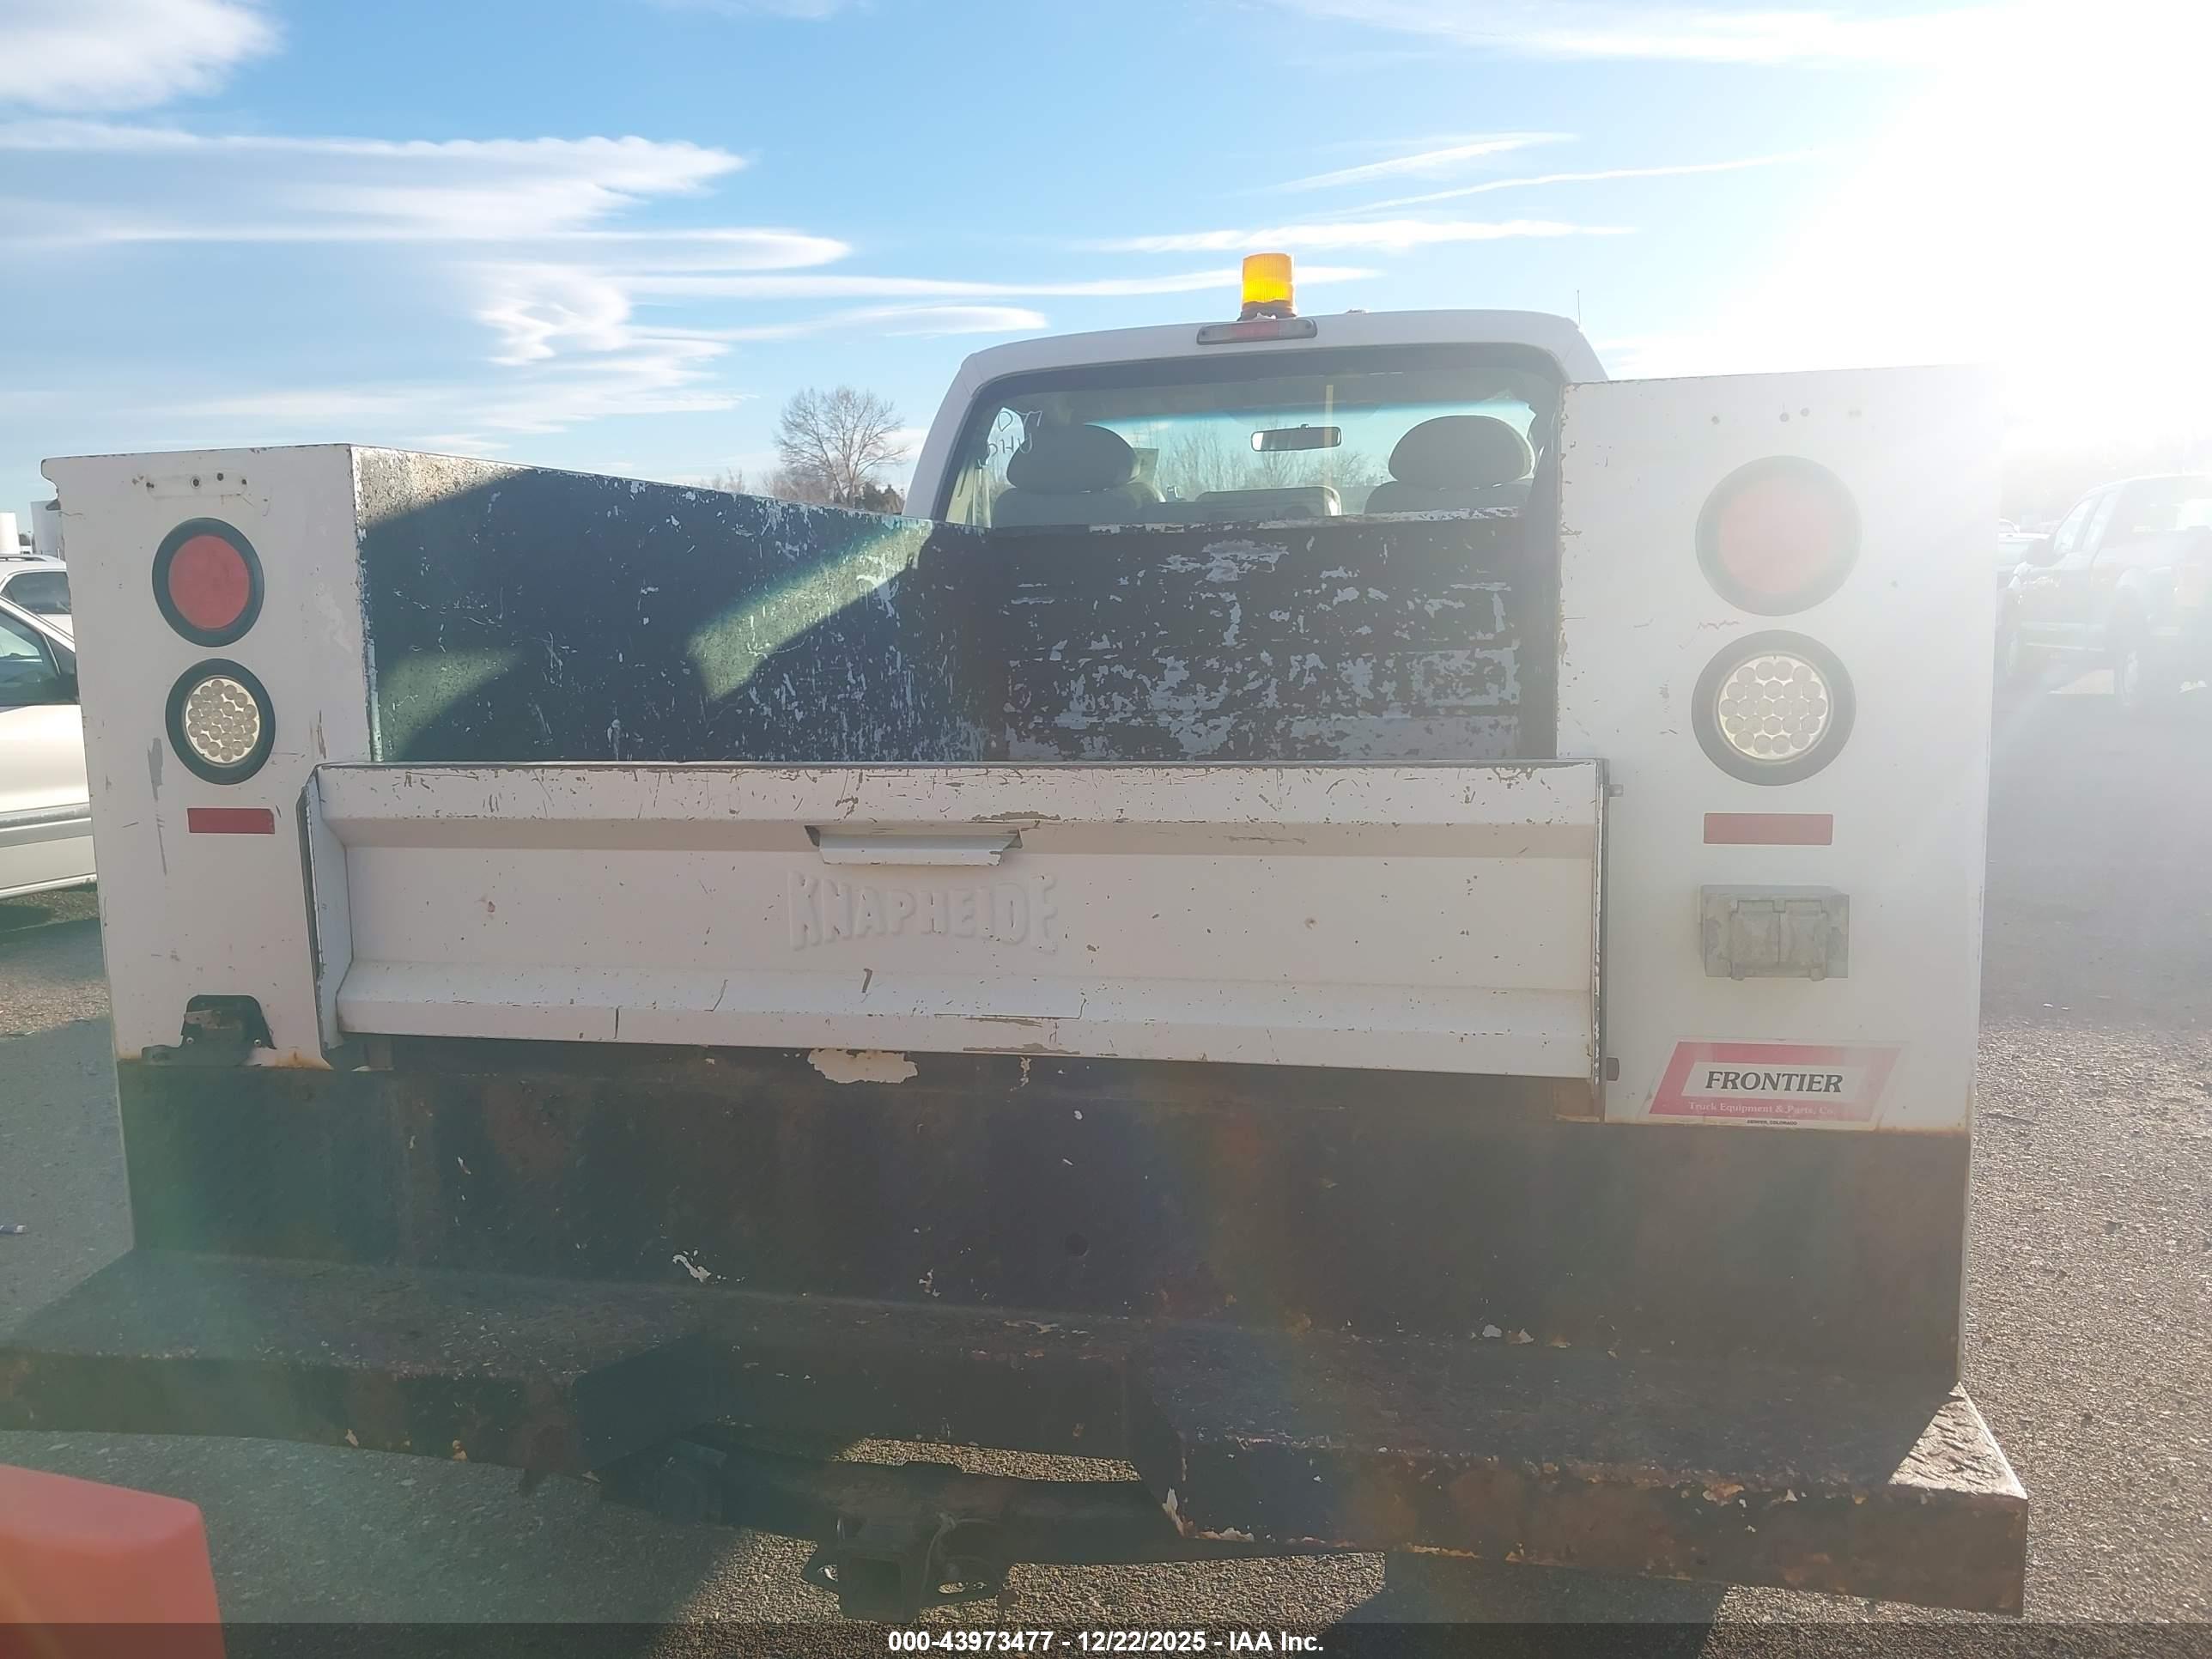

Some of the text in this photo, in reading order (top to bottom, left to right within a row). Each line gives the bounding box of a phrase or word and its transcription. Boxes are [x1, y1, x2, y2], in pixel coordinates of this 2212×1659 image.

[787, 869, 1059, 955] KNAPHEIDE
[1705, 1070, 1844, 1094] FRONTIER
[1689, 1101, 1717, 1111] Truck
[1720, 1103, 1772, 1114] Equipment
[1775, 1104, 1784, 1113] &
